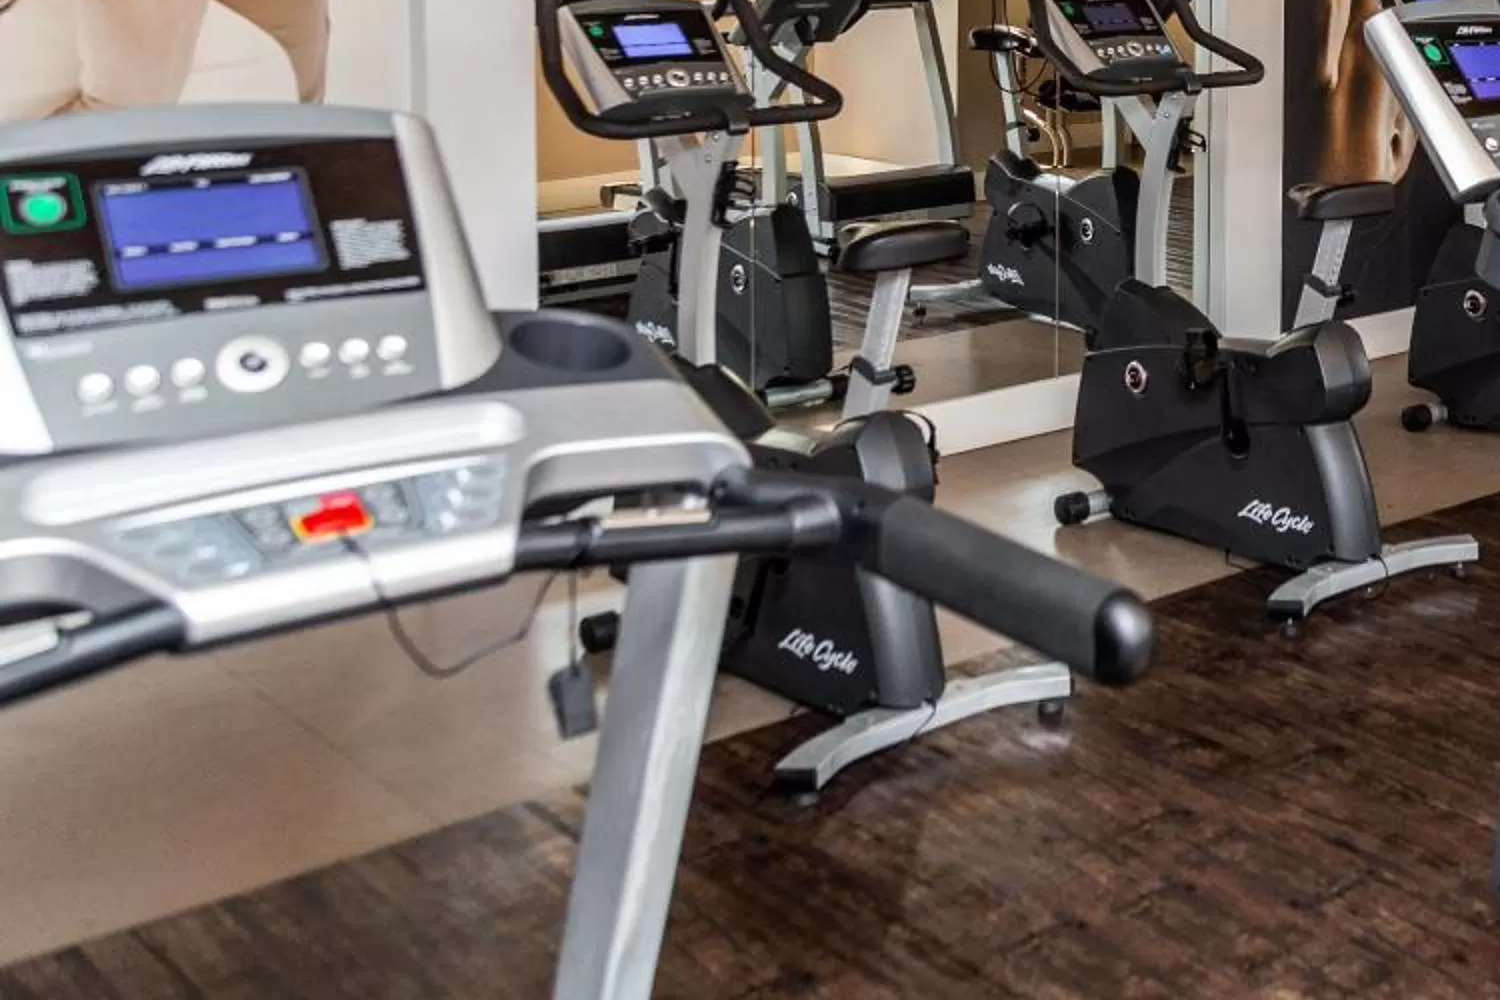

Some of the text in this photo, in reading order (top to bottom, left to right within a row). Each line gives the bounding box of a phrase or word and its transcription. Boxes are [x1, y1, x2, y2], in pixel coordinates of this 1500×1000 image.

[1237, 499, 1316, 534] Life Cycle
[812, 638, 859, 674] Cycle
